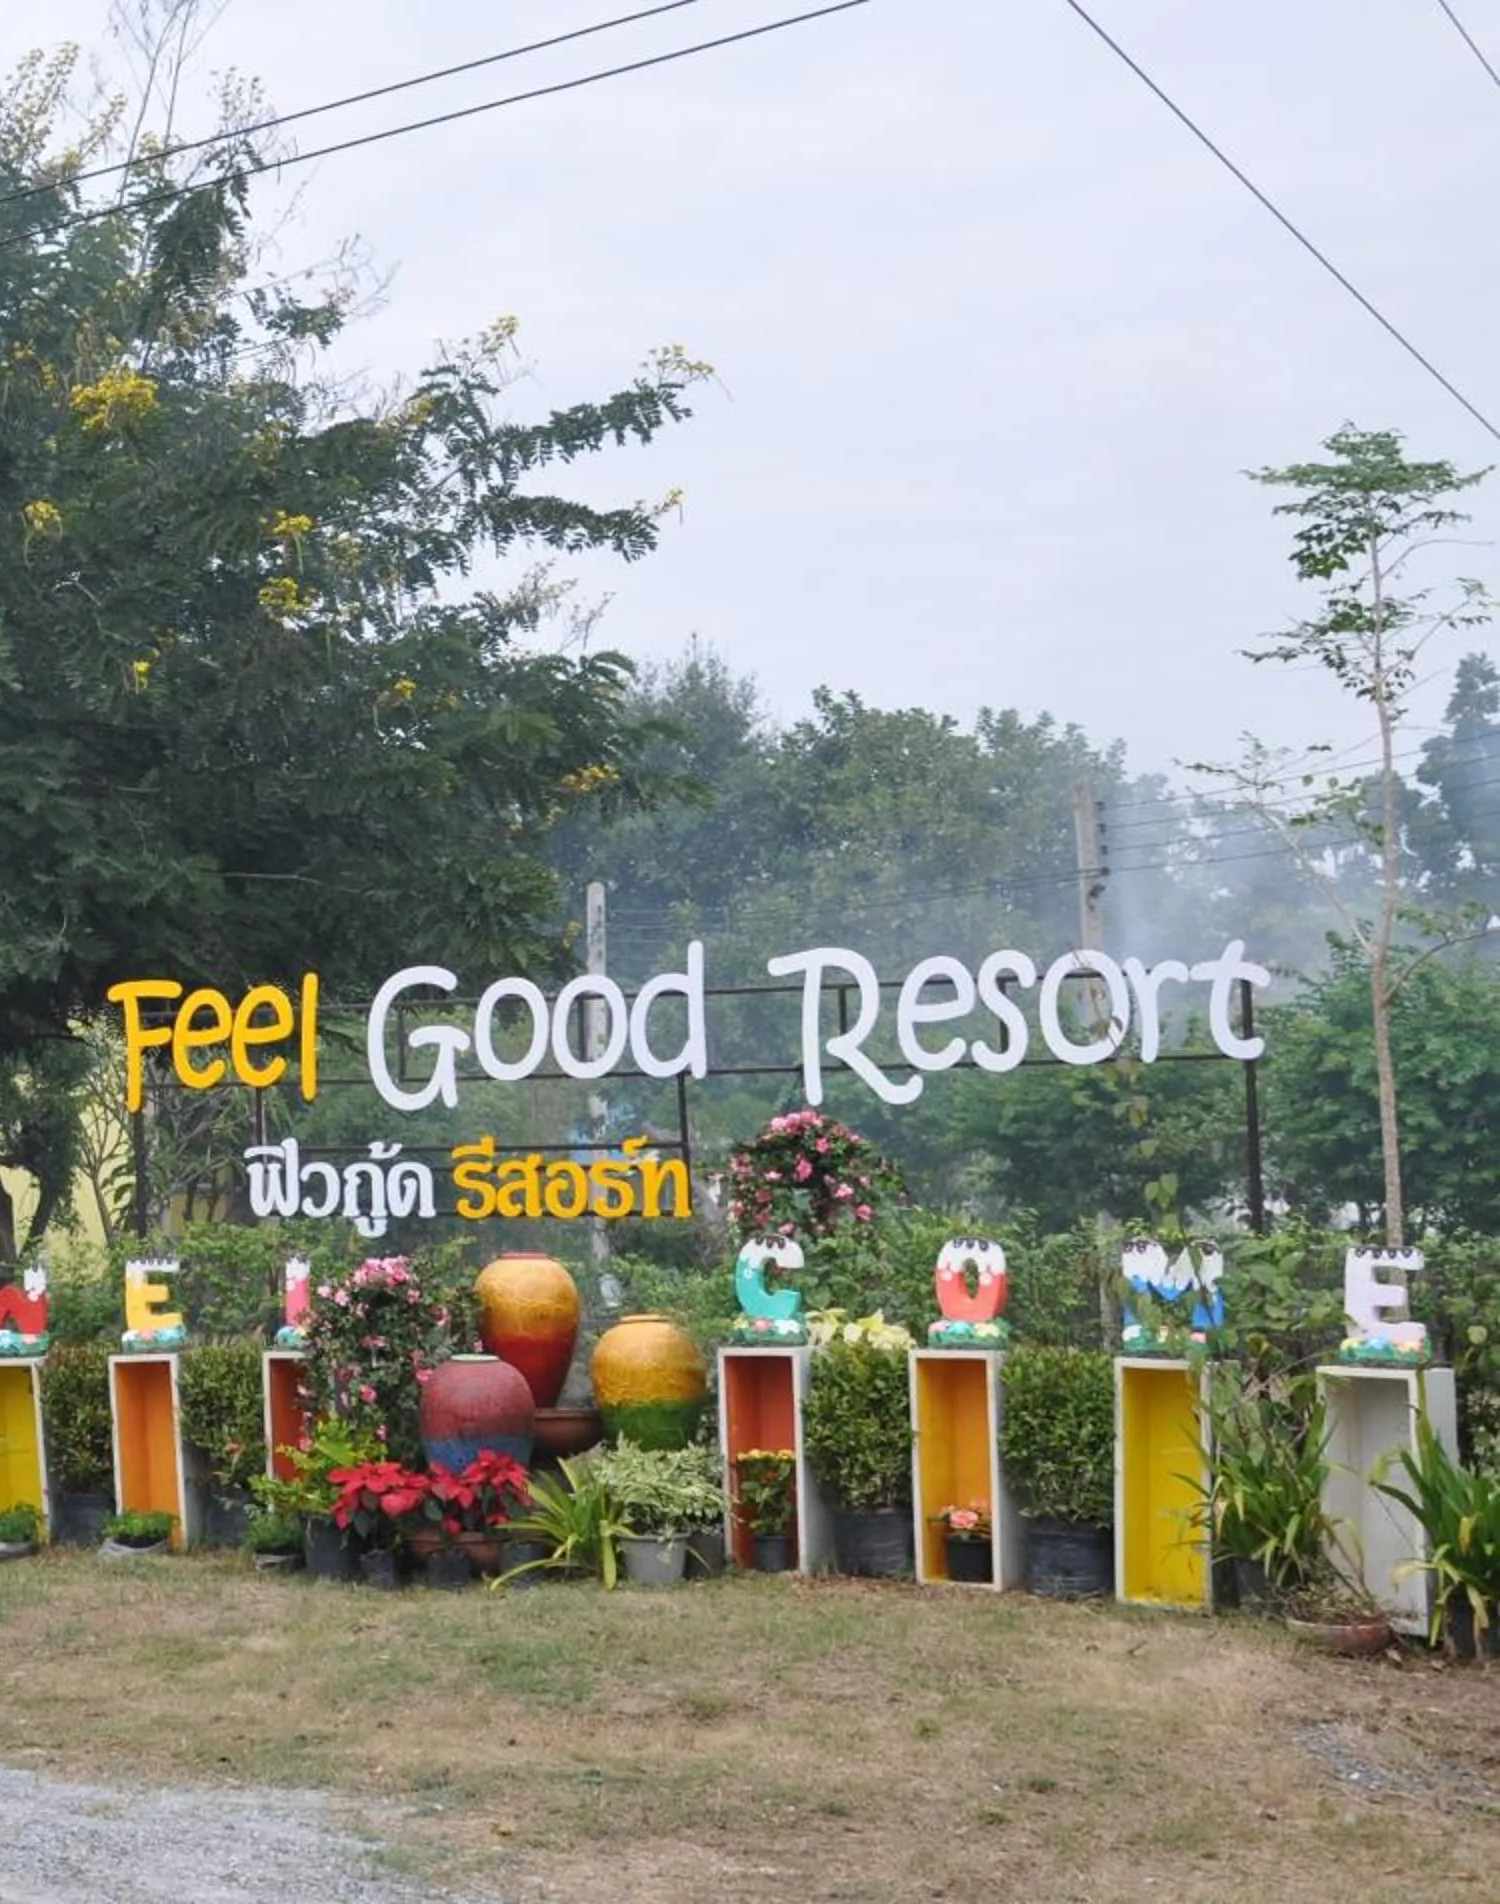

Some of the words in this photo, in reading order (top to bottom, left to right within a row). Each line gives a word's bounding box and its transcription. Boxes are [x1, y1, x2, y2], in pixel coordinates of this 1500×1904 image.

[108, 972, 319, 1113] Feel
[367, 940, 708, 1111] Good
[767, 939, 1271, 1106] Resort
[451, 1134, 693, 1219] รีสอร์ท
